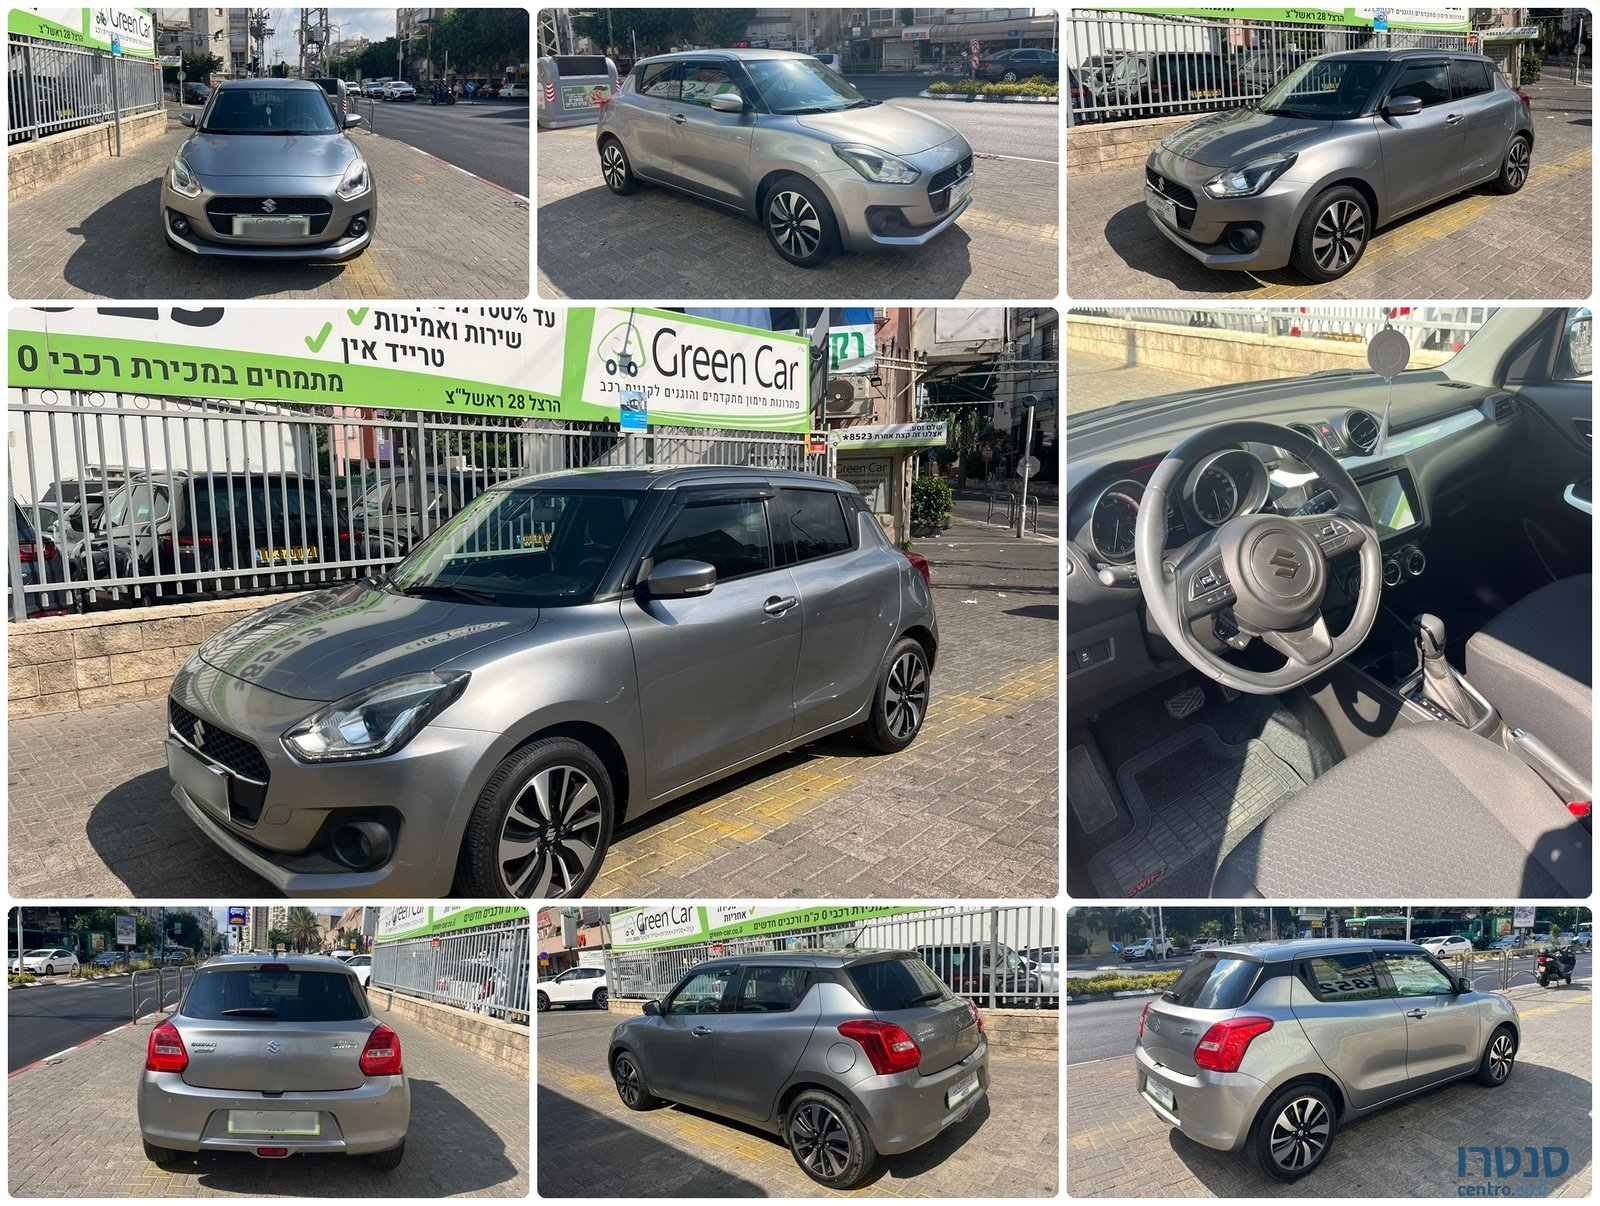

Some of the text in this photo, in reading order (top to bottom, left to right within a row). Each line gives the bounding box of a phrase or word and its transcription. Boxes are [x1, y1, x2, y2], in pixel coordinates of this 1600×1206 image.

[110, 8, 151, 37] Green Car
[1317, 12, 1326, 20] 28
[1327, 13, 1345, 22] הרצל
[63, 29, 71, 38] 28
[374, 311, 522, 349] שירות ואמינות
[341, 337, 445, 368] טרייד אין
[652, 327, 799, 391] Green Car
[17, 344, 344, 393] מתמחים במכירת רכבי 0
[664, 388, 698, 400] והוגנים
[703, 391, 743, 405] מתקדמים
[508, 394, 525, 410] 28
[529, 395, 561, 413] הרצל
[746, 395, 767, 407] מימון
[770, 399, 800, 409] פתרונות
[868, 462, 887, 473] Car
[1127, 865, 1168, 897] SWIFT
[463, 909, 482, 923] חדשים
[636, 906, 693, 932] Green Car
[724, 911, 747, 923] אחריות
[829, 907, 849, 919] רכבי
[753, 919, 777, 931] חדשים
[778, 916, 803, 928] ורכבים
[709, 926, 743, 939] green-car.co.il
